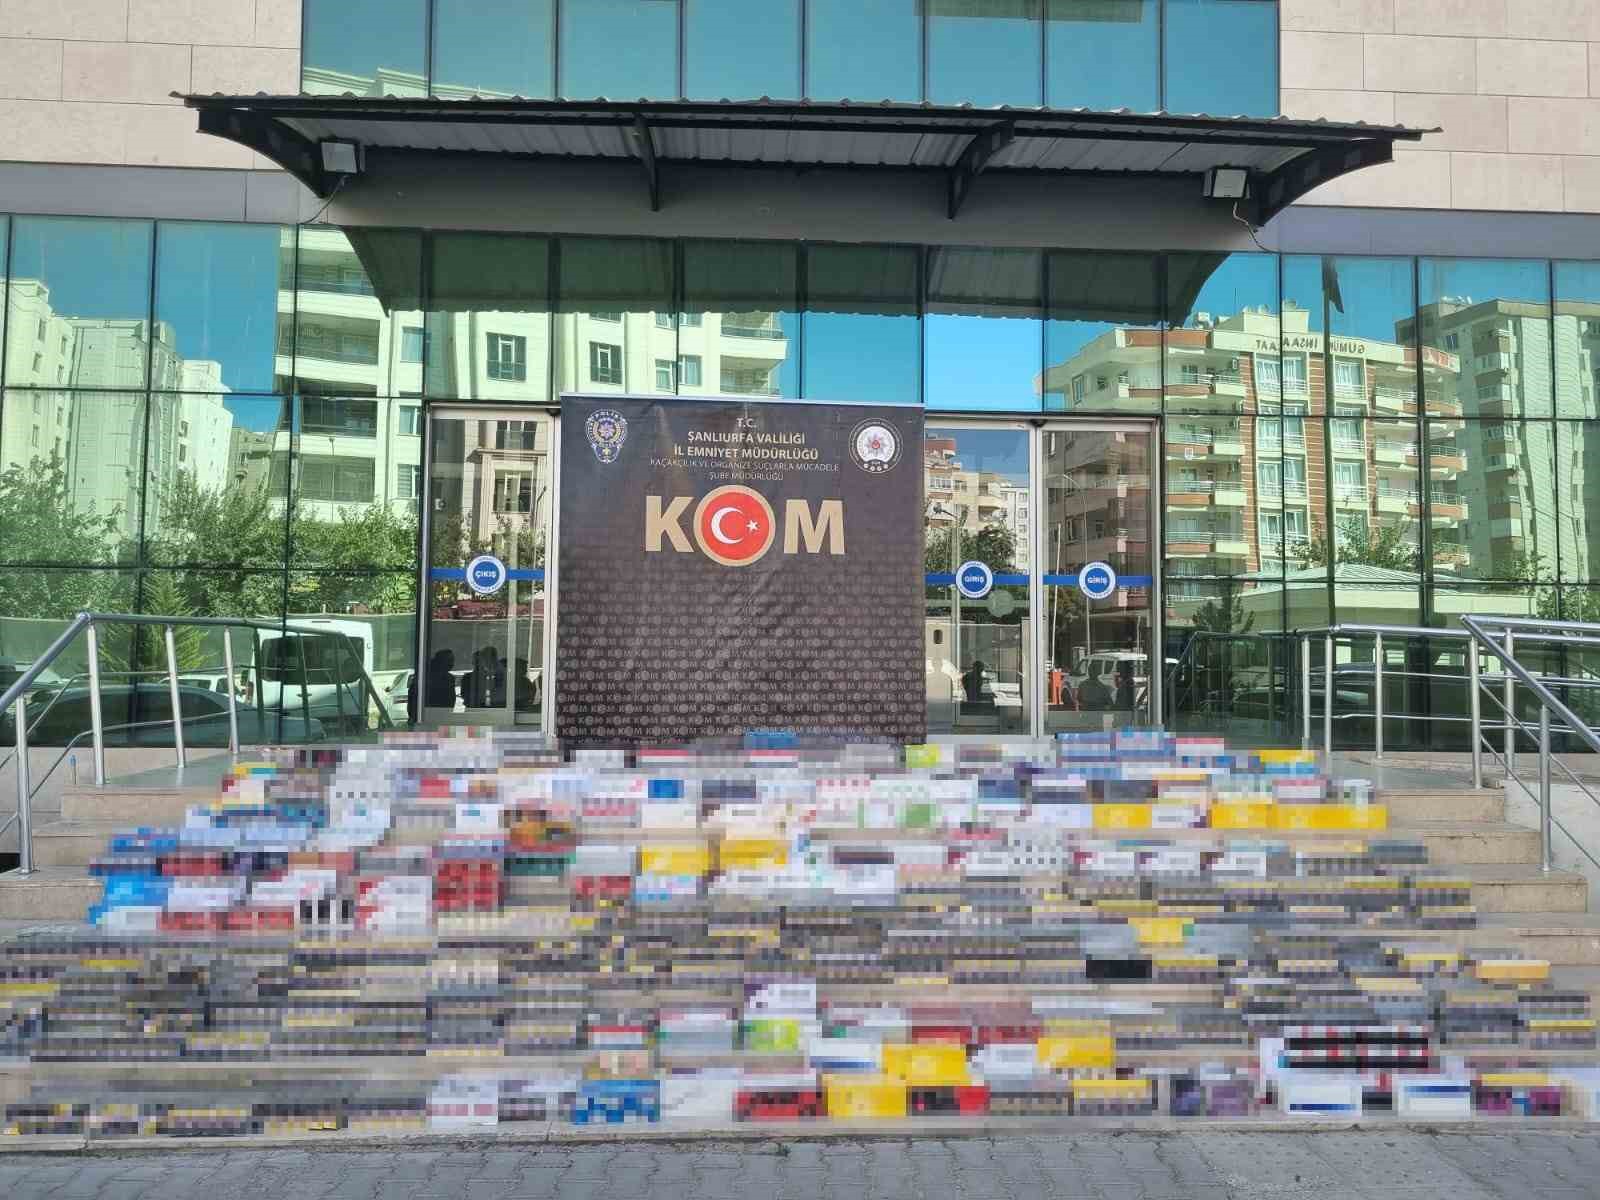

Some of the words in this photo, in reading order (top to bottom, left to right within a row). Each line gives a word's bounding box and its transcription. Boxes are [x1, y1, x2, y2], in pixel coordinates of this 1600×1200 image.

[736, 417, 757, 428] T.C.
[688, 431, 754, 443] ŞANLIURFA
[757, 432, 806, 445] VALİLİĞİ
[674, 443, 684, 456] İL
[688, 446, 739, 458] EMNİYET
[742, 447, 818, 460] MÜDÜRLÜĞÜ
[645, 485, 845, 567] KOM
